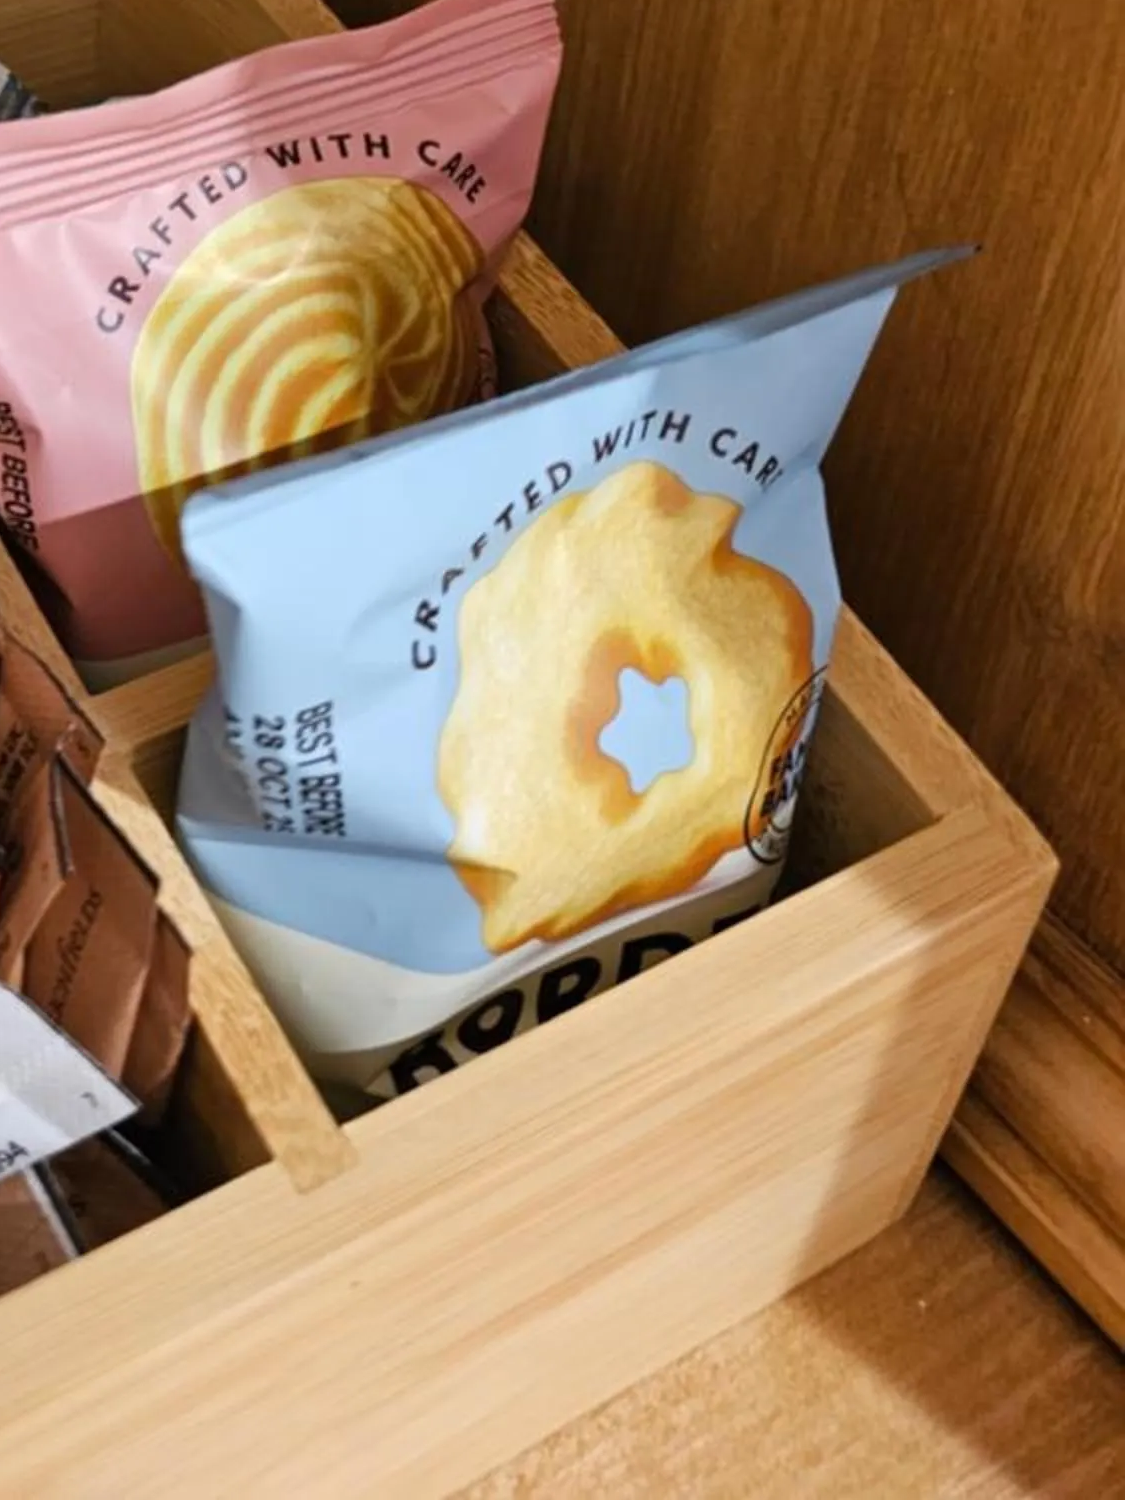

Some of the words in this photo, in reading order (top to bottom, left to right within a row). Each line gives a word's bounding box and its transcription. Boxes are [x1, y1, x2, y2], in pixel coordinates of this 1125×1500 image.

[96, 160, 249, 335] CRAFTED
[266, 132, 392, 169] WITH
[416, 139, 489, 205] CARE
[411, 461, 573, 672] CRAFTED
[591, 409, 691, 465] WITH
[256, 756, 293, 810] OCT
[295, 699, 338, 768] BEST
